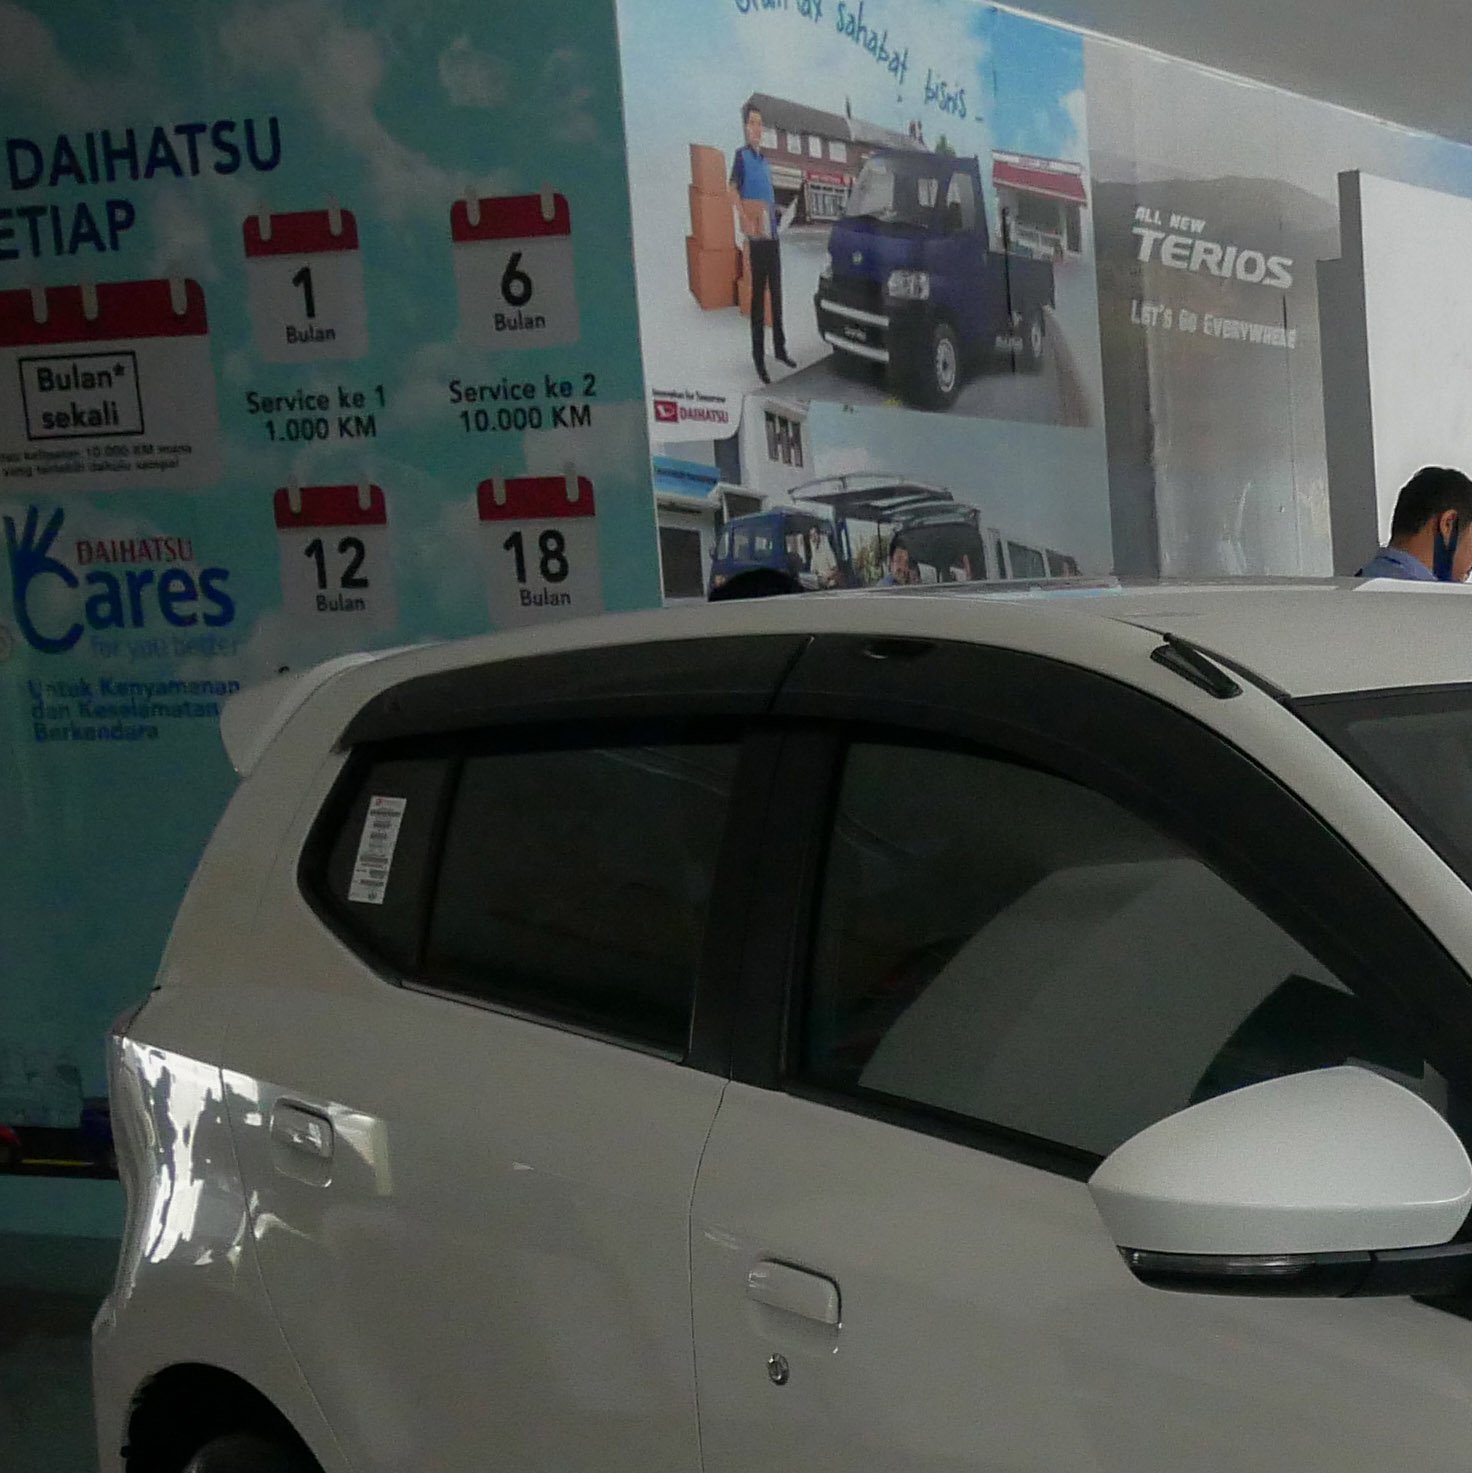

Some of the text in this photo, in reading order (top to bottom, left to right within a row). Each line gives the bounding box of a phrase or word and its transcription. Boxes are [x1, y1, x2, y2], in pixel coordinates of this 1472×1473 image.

[6, 116, 282, 190] DAIHATSU
[1134, 206, 1206, 233] ALL NEW
[1131, 226, 1293, 289] TERIOS
[291, 266, 316, 319] 1
[500, 252, 533, 307] 6
[286, 325, 335, 344] Bulan
[494, 311, 546, 332] Bulan
[246, 384, 386, 415] Service ke 1
[449, 373, 597, 404] Service ke 2
[42, 400, 119, 429] sekali
[266, 414, 377, 441] 1.000 KM
[460, 404, 592, 433] 10.000 KM
[77, 537, 193, 565] DAIHATSU
[304, 536, 369, 589] 12
[503, 529, 569, 583] 18
[316, 594, 366, 612] Bulan
[520, 589, 571, 607] Bulan
